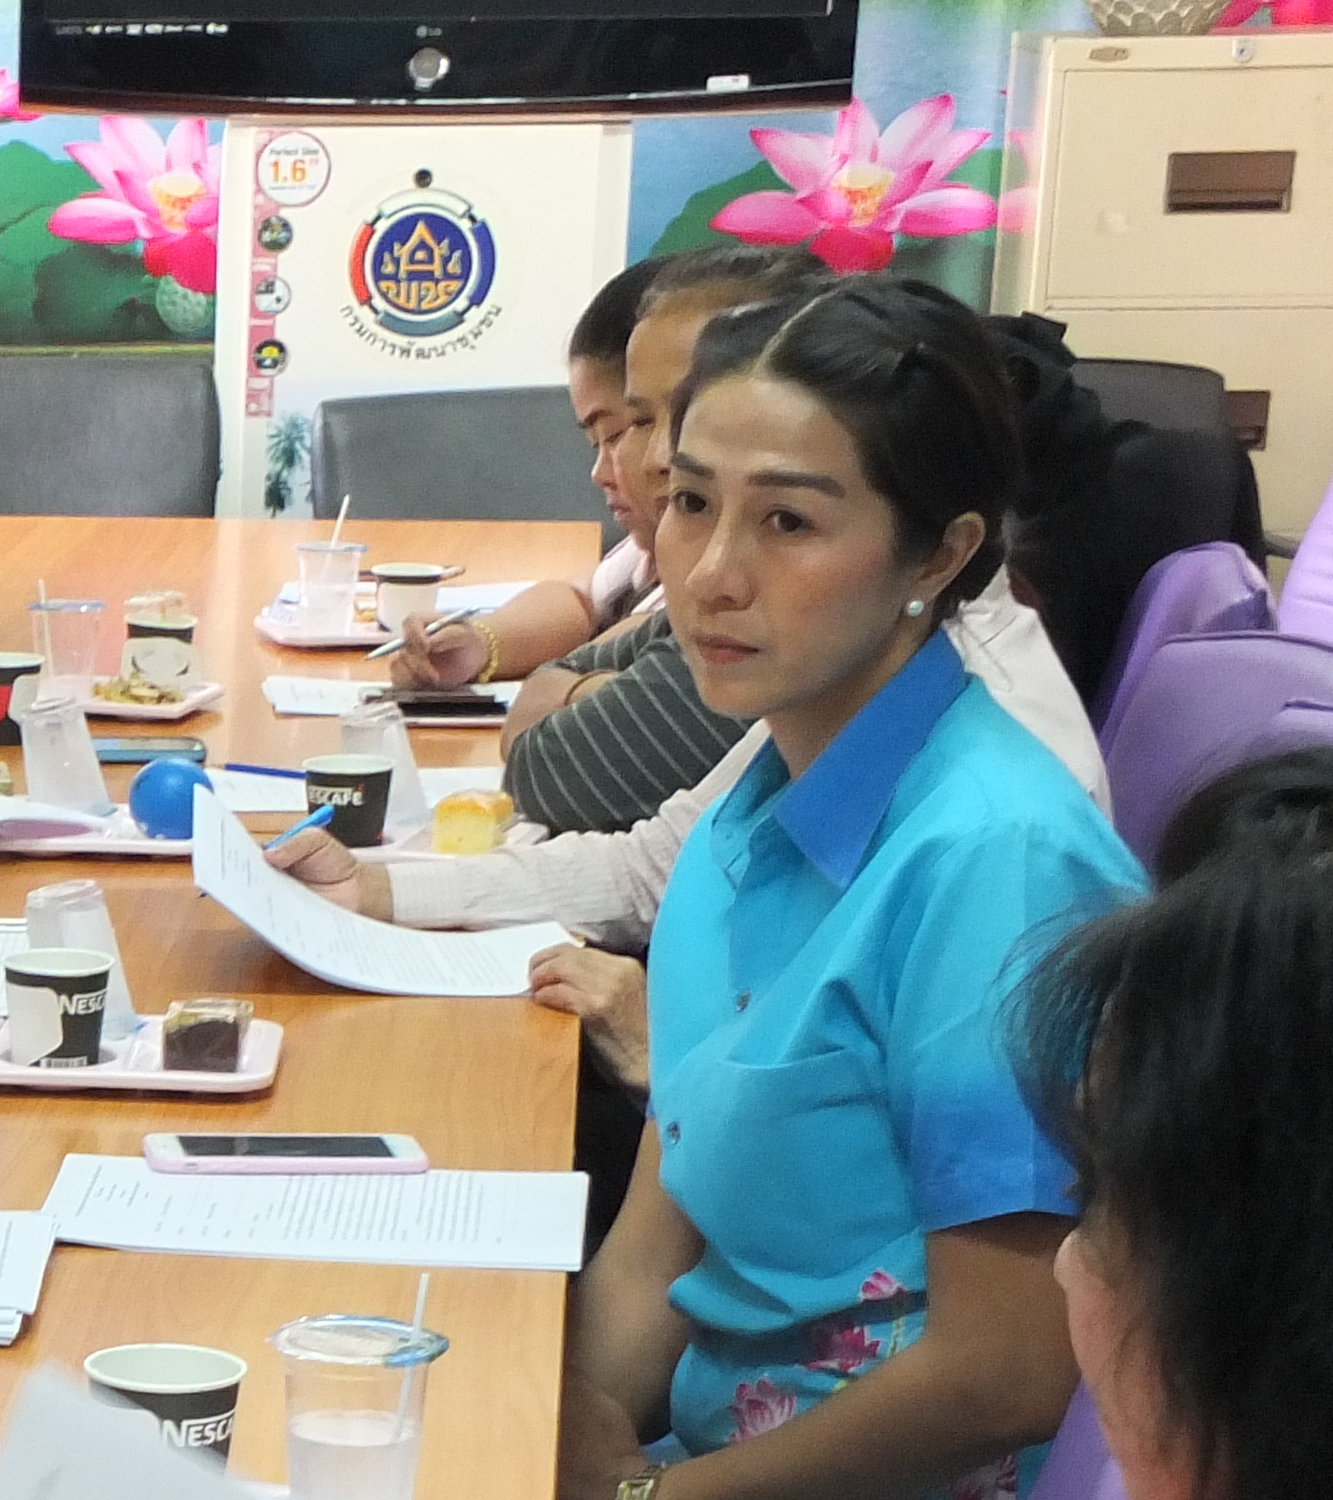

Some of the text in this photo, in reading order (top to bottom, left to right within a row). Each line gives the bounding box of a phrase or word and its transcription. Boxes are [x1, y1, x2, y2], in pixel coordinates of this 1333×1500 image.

[339, 303, 503, 361] กรมการพัฒนาชุมชน
